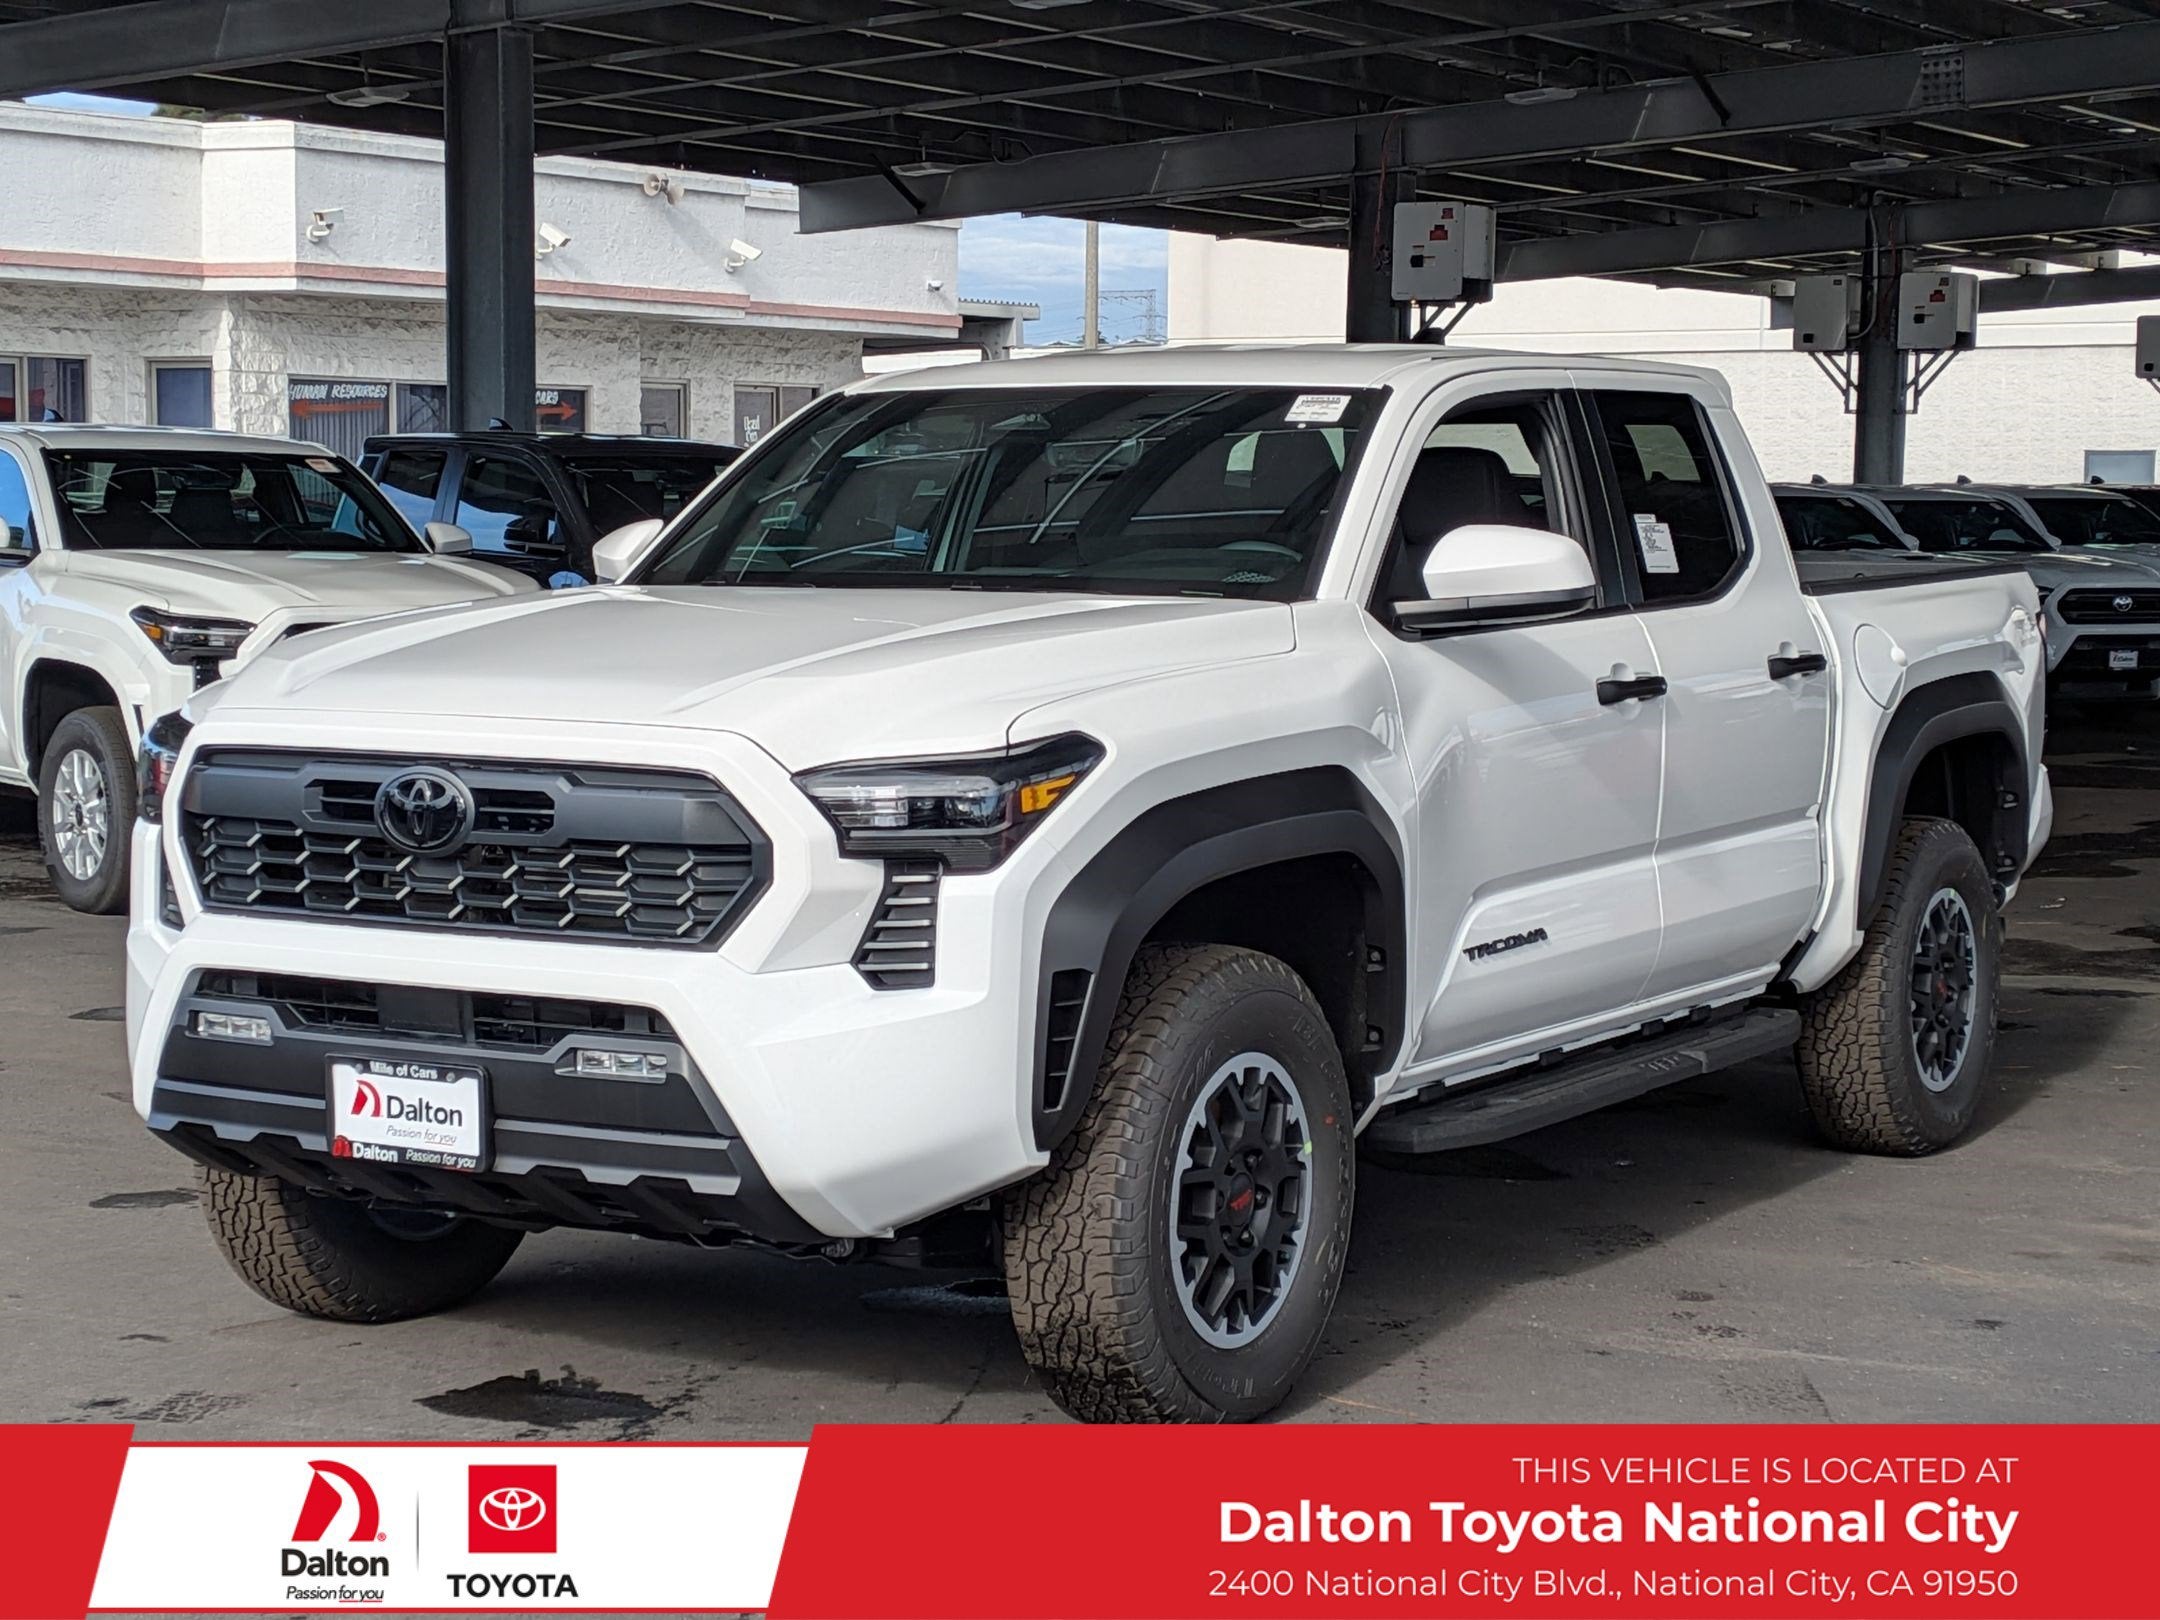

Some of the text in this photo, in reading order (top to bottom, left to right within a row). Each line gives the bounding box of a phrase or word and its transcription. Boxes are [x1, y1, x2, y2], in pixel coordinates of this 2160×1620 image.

[289, 384, 388, 400] HUMAN RESOURCES
[1462, 927, 1549, 962] TACOMA
[369, 1061, 438, 1080] Mile of Cars
[386, 1095, 463, 1127] Dalton
[386, 1126, 458, 1145] Passion for you
[352, 1142, 399, 1163] Dalton
[405, 1149, 476, 1169] Passion for you
